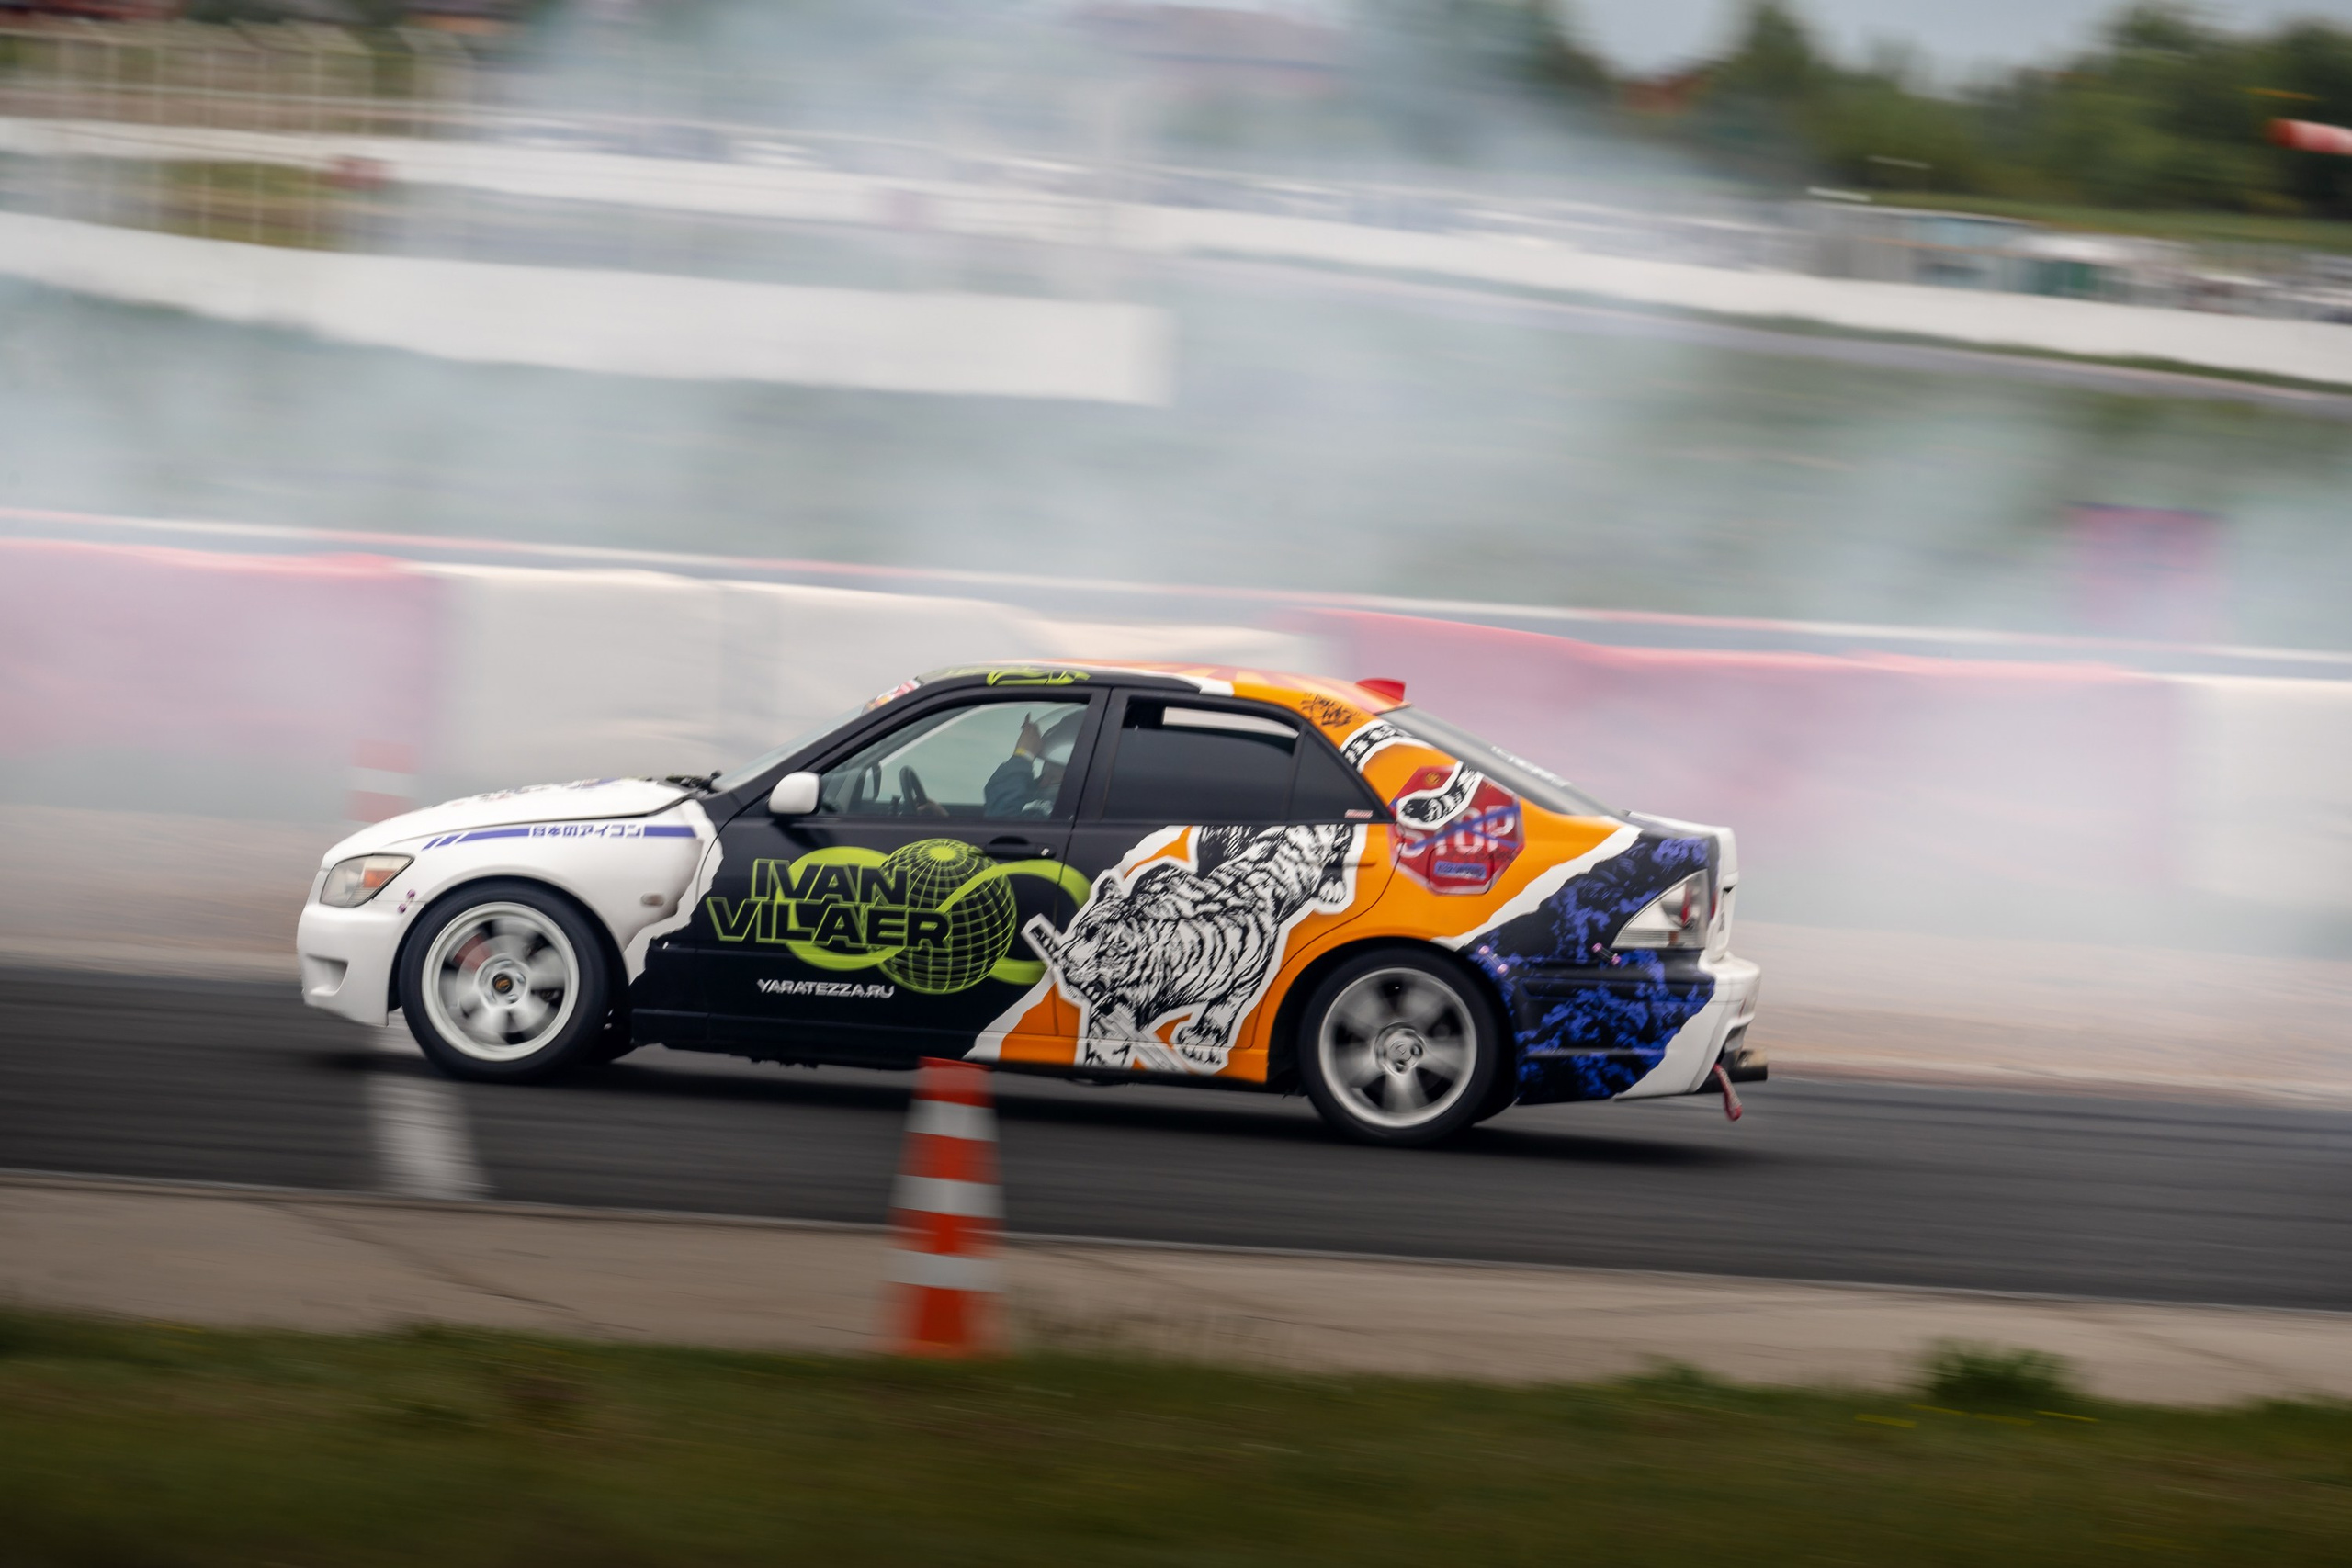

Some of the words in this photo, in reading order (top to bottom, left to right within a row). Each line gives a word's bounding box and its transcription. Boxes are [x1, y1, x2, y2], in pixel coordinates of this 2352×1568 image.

[529, 823, 642, 838] 日本のアイコン
[751, 857, 912, 908] IVAN
[706, 896, 954, 952] VILAER
[756, 979, 895, 999] YARATEZZA.RU
